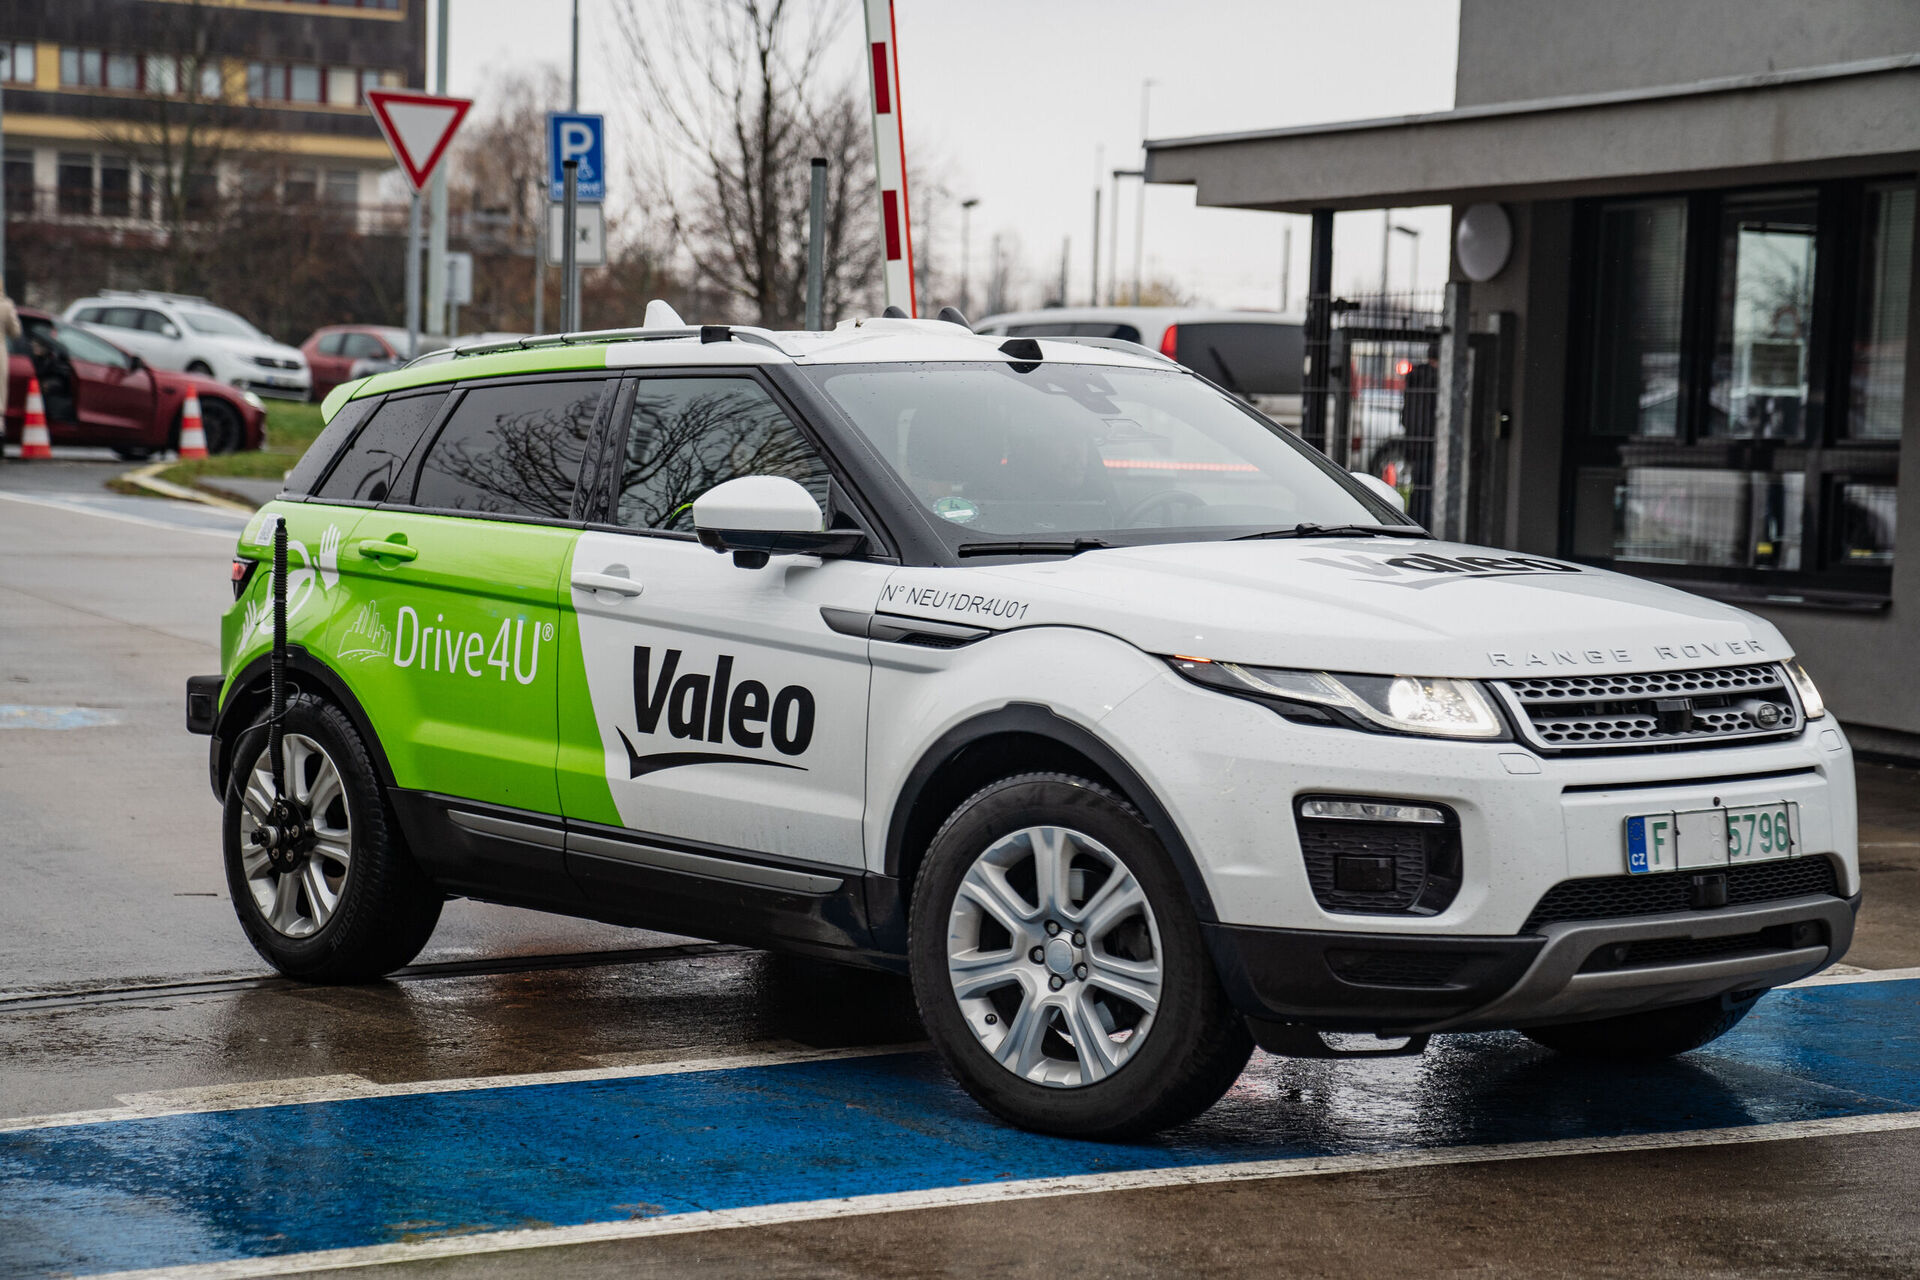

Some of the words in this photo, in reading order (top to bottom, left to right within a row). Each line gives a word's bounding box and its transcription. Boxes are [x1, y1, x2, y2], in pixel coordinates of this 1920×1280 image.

[560, 121, 594, 168] P
[1299, 553, 1583, 577] Valeo
[906, 587, 1029, 620] NEU1DR4U01
[1486, 648, 1633, 667] RANGE
[1653, 639, 1766, 660] ROVER
[633, 645, 815, 756] Valeo
[1652, 821, 1668, 865] F
[1727, 811, 1789, 857] 5796
[1631, 853, 1645, 866] CZ
